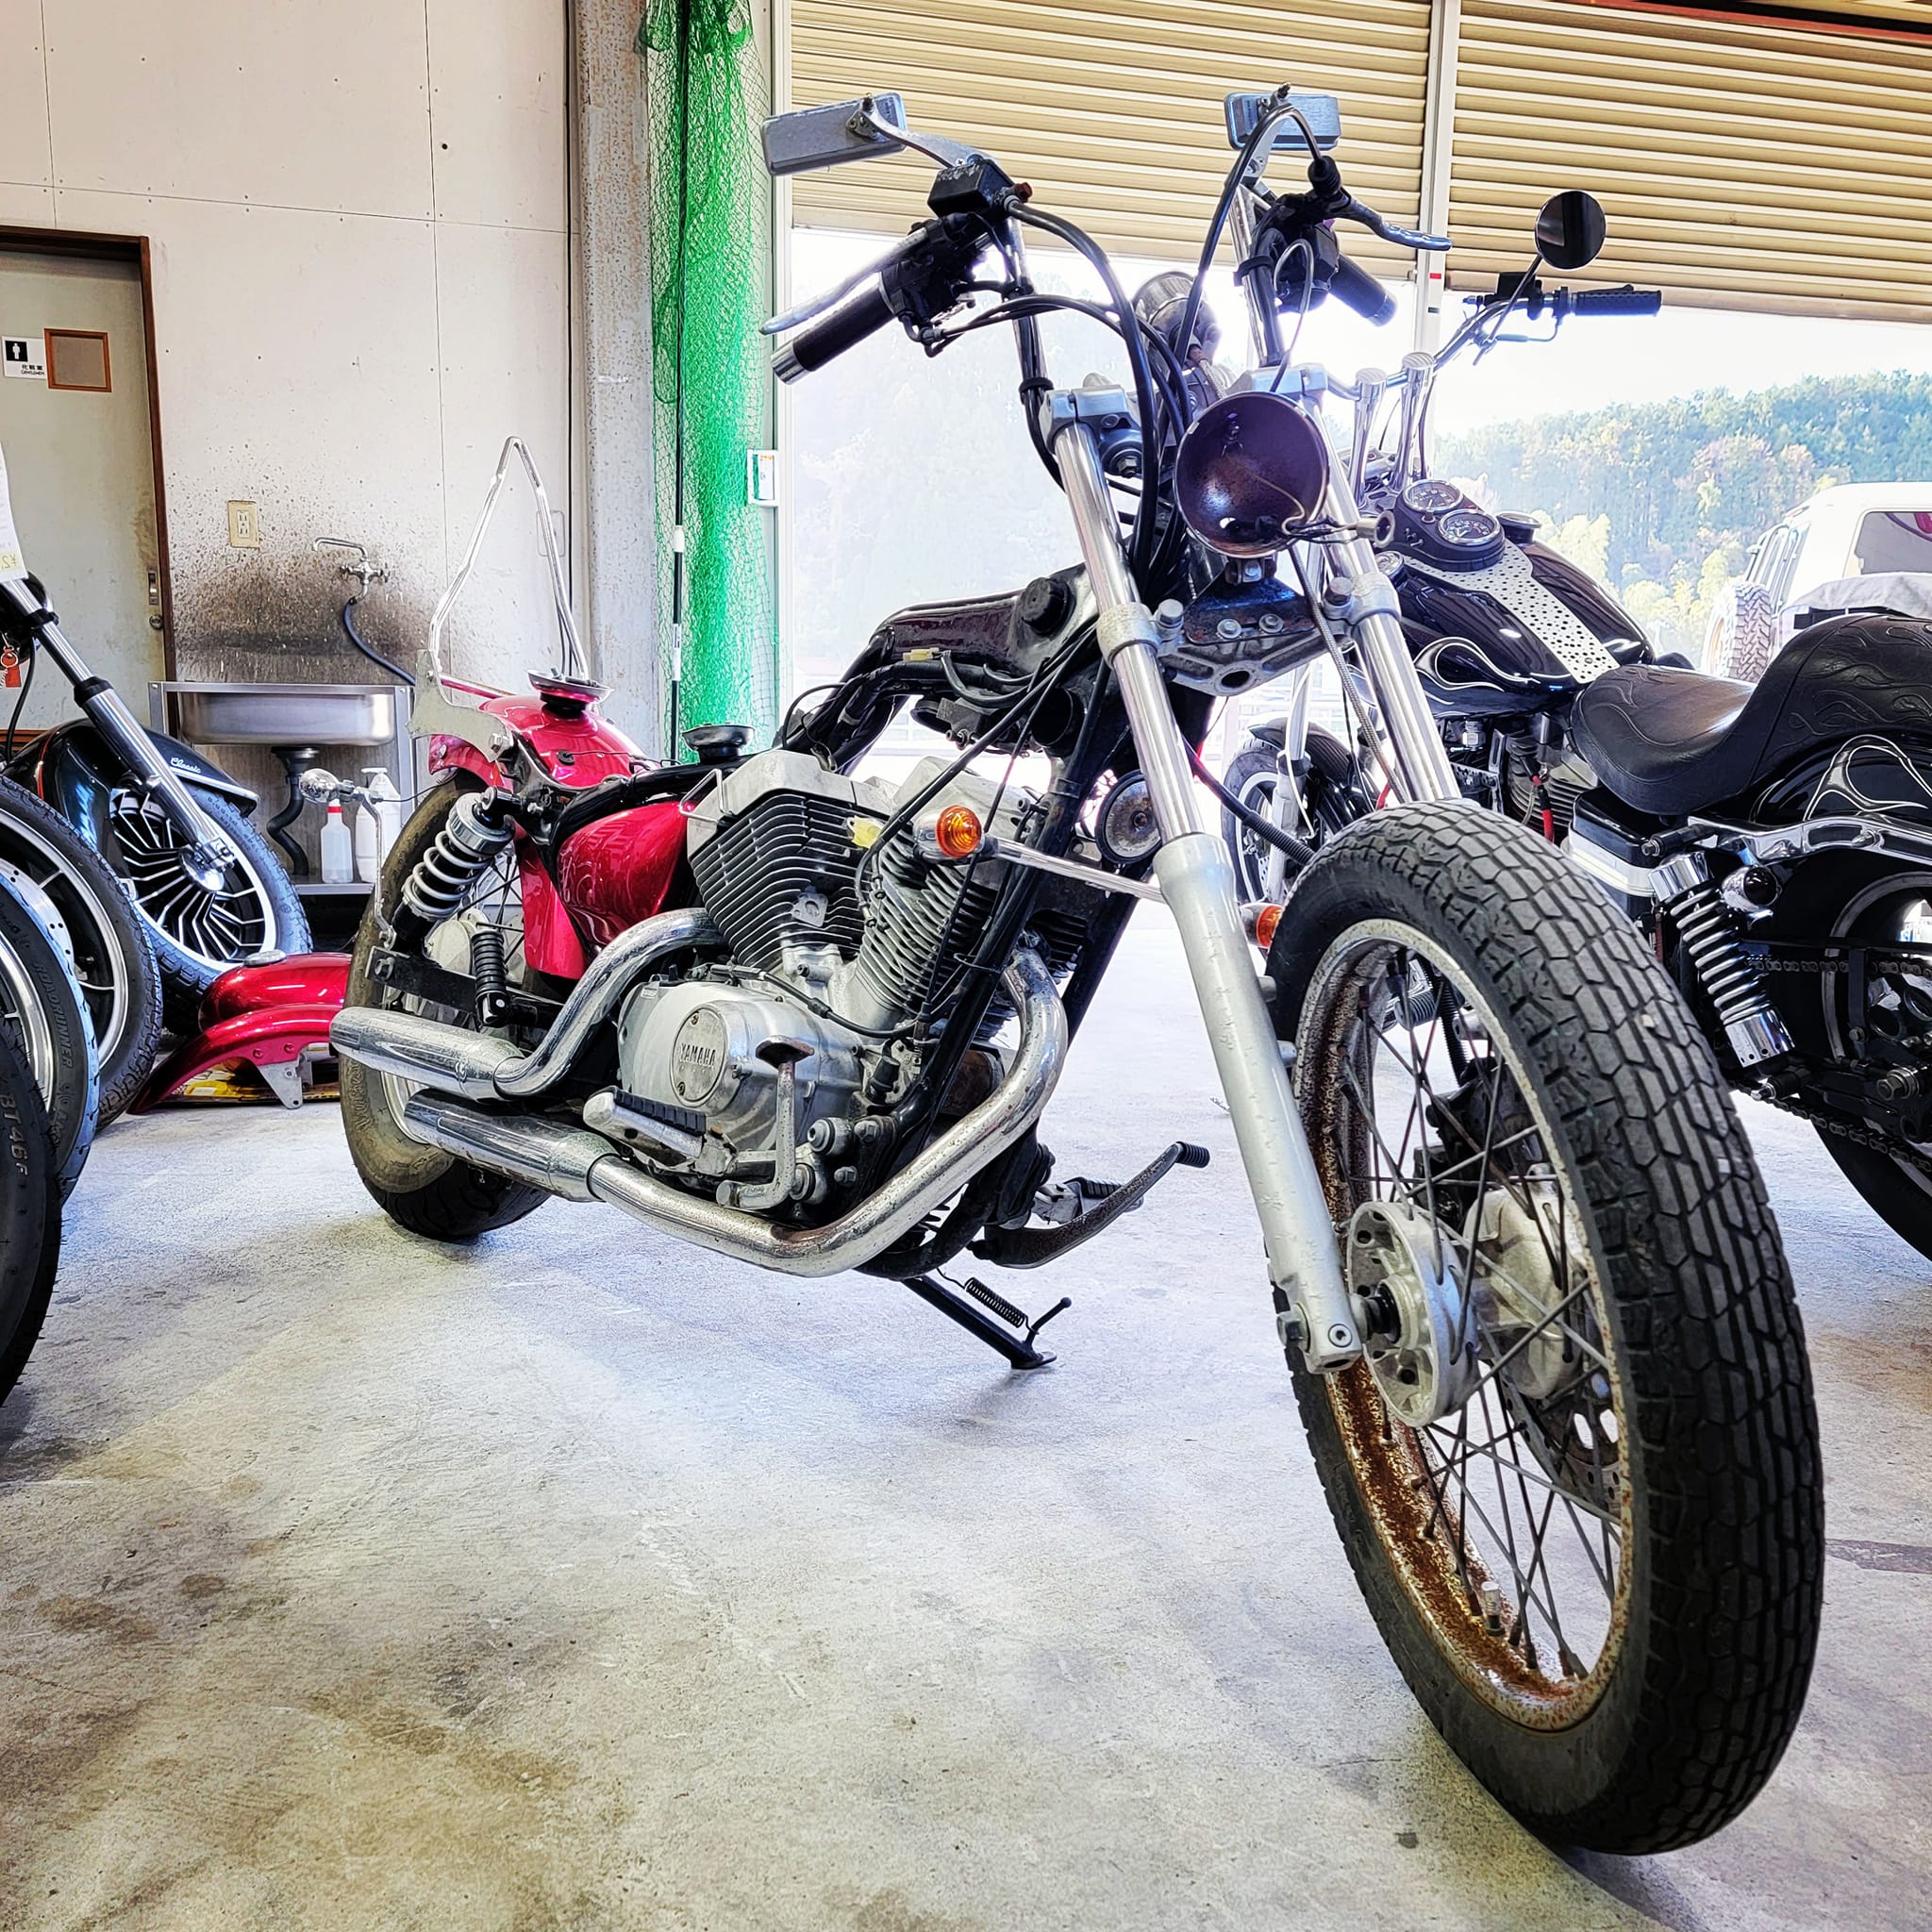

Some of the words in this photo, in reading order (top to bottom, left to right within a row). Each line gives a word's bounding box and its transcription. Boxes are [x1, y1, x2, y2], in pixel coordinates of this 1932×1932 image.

[170, 757, 202, 774] Classic
[33, 962, 74, 1069] ROADRUNNER
[680, 1043, 717, 1067] YAMAHA
